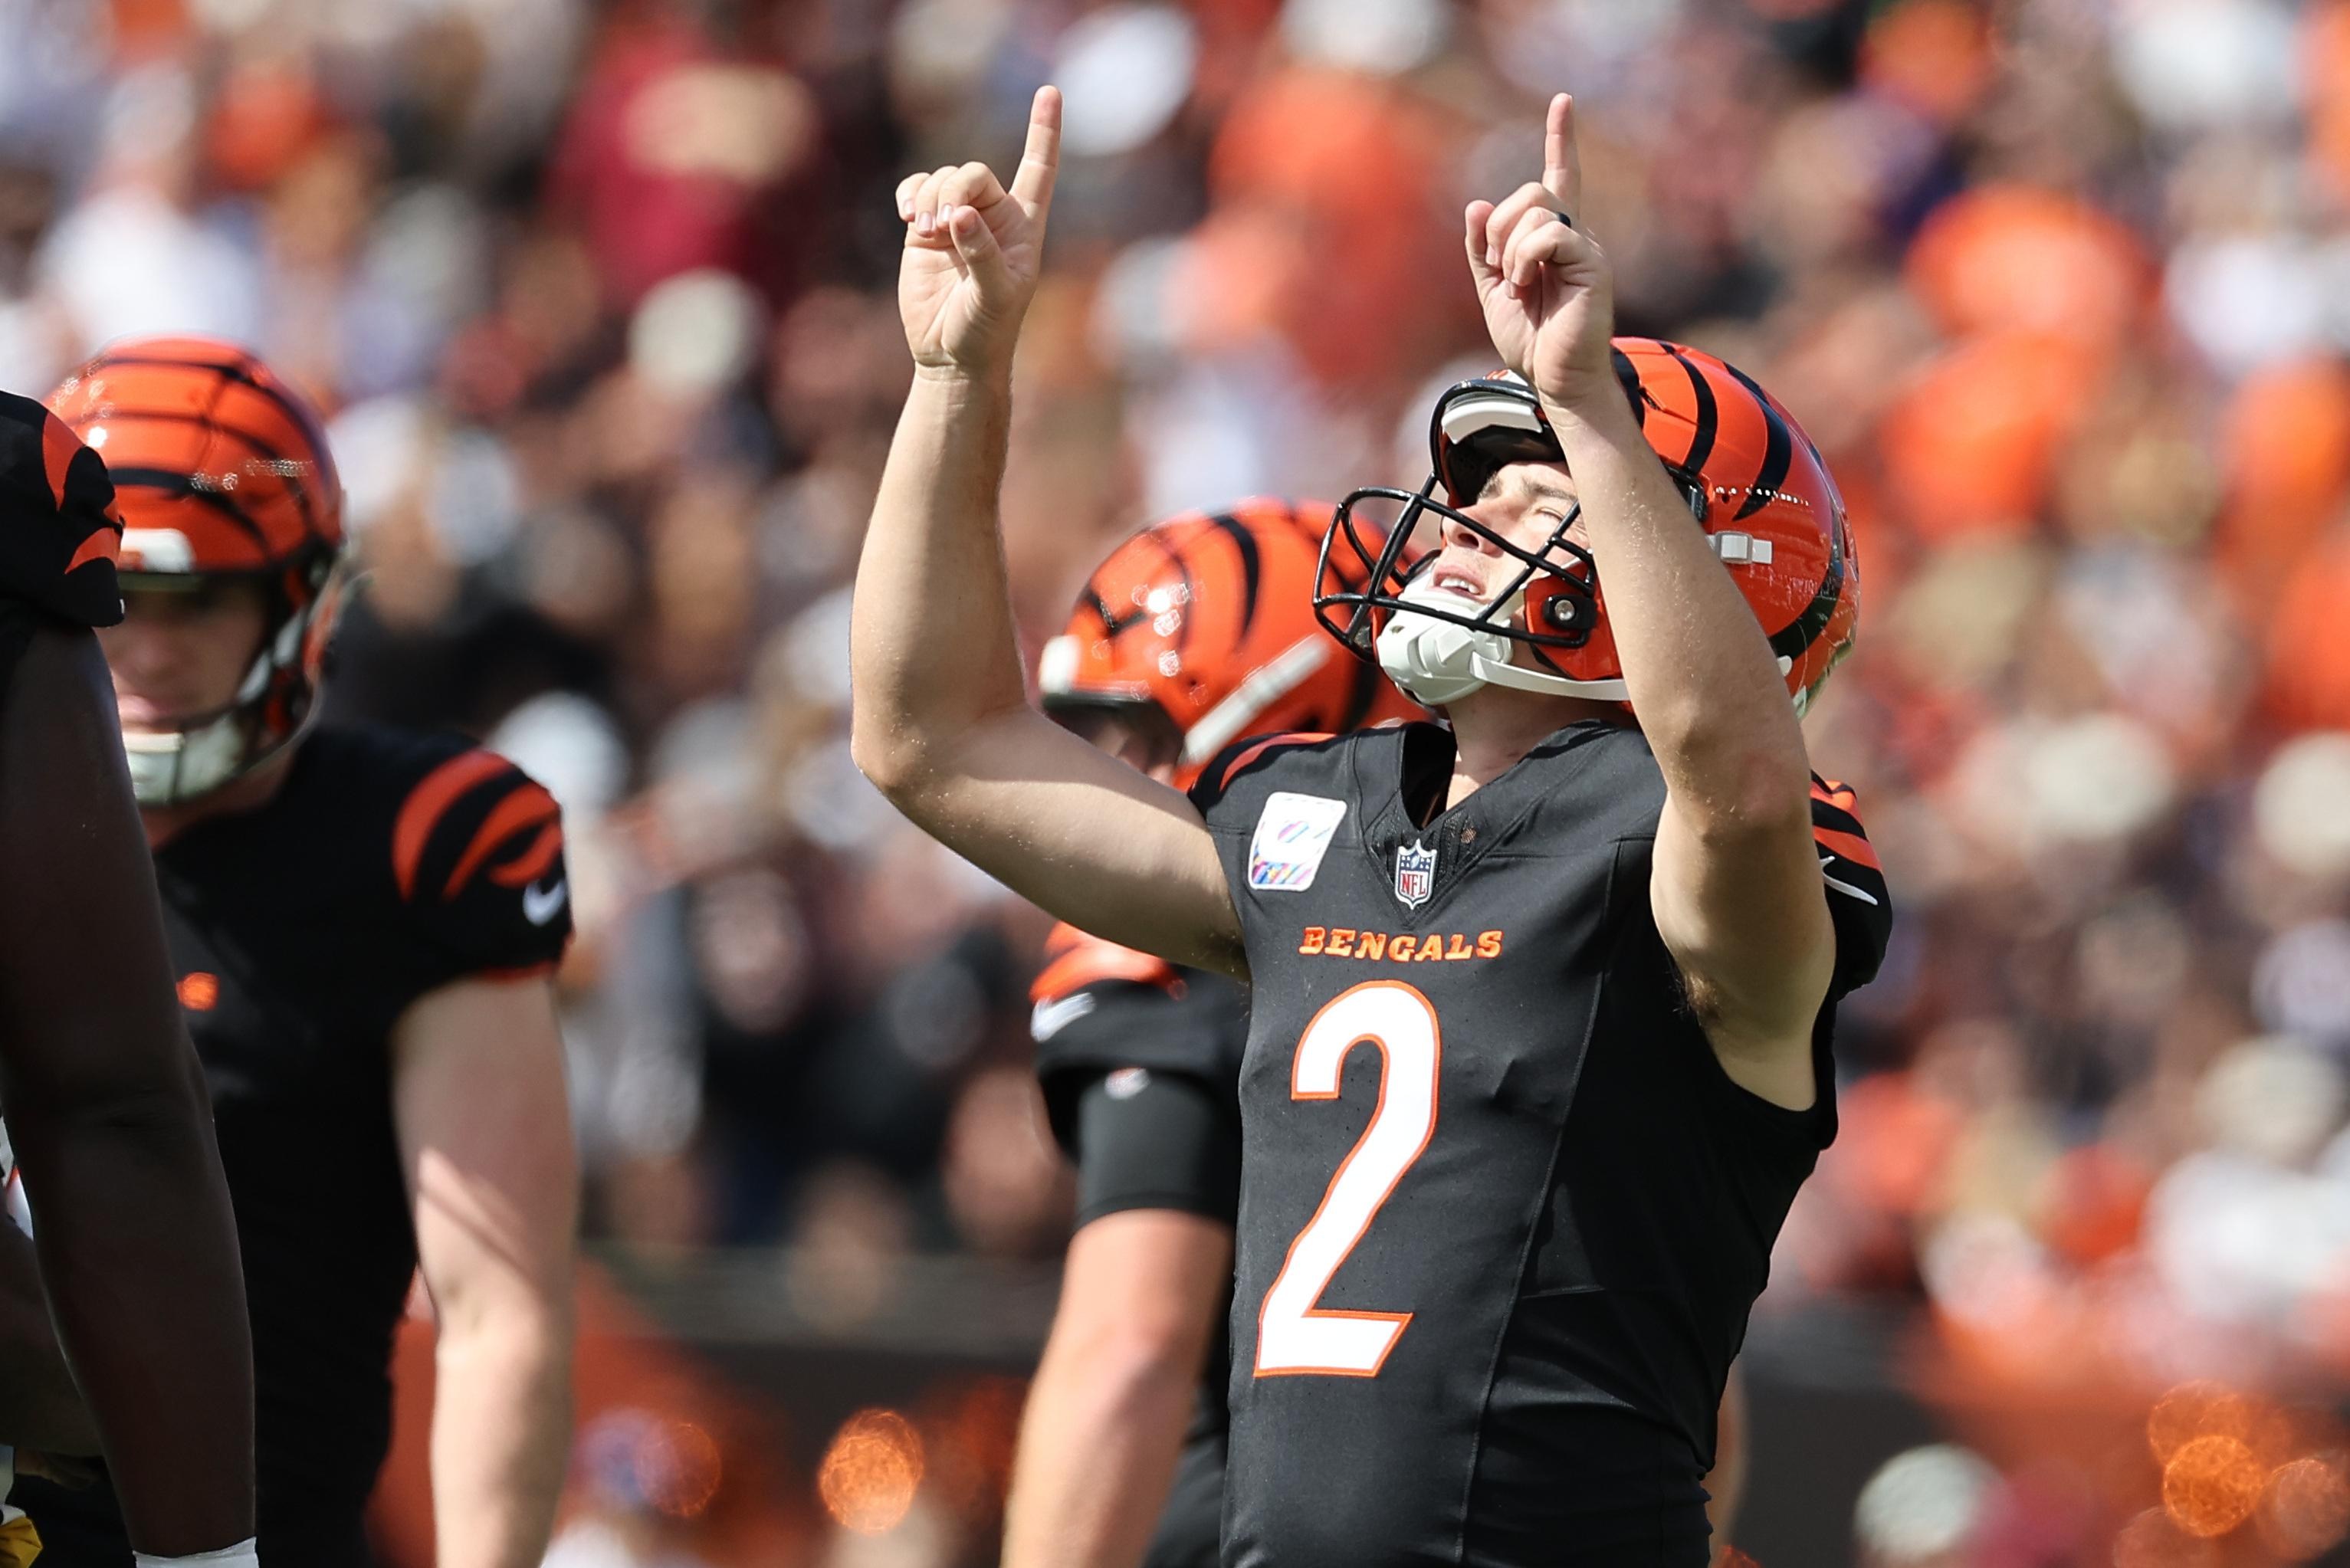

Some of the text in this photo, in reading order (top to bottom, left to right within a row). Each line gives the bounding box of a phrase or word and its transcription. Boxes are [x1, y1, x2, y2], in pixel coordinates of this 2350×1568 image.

[1400, 873, 1426, 897] NFL
[1298, 926, 1504, 963] BENGALS
[1253, 980, 1441, 1379] 2
